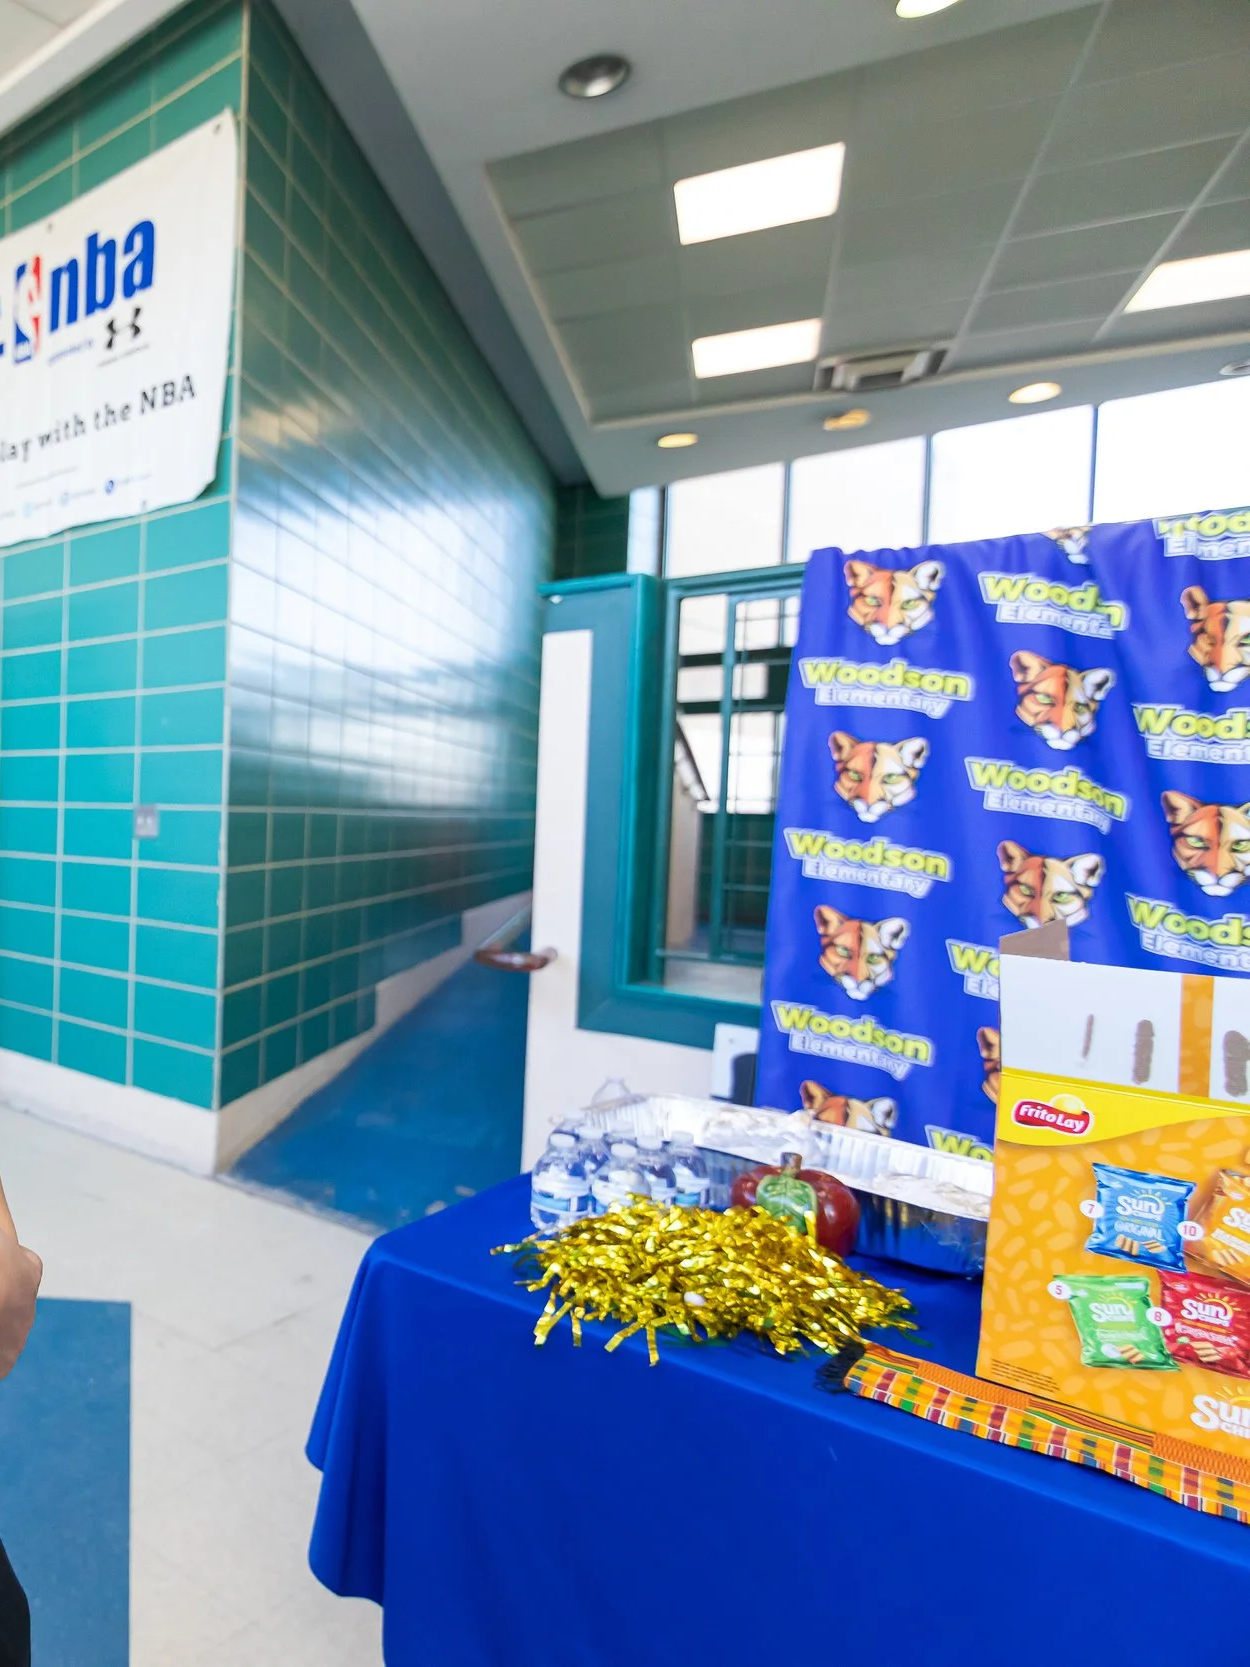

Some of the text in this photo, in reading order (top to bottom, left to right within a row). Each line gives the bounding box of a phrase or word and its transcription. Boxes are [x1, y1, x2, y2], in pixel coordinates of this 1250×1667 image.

[50, 220, 155, 334] nba
[38, 413, 87, 449] with
[94, 401, 132, 430] the
[140, 374, 196, 415] NBA
[803, 660, 969, 698] Woodson
[817, 685, 951, 719] Elementary
[1132, 706, 1250, 741] Wood
[968, 760, 1125, 819] Woodson
[788, 831, 948, 879] Woodson
[805, 859, 931, 897] Elementary
[775, 1004, 931, 1063] Woodson
[790, 1031, 911, 1080] Elementary
[1087, 1202, 1096, 1215] 7
[1116, 1194, 1165, 1217] Sun
[1182, 1224, 1198, 1238] 10
[1180, 1297, 1234, 1325] Sun
